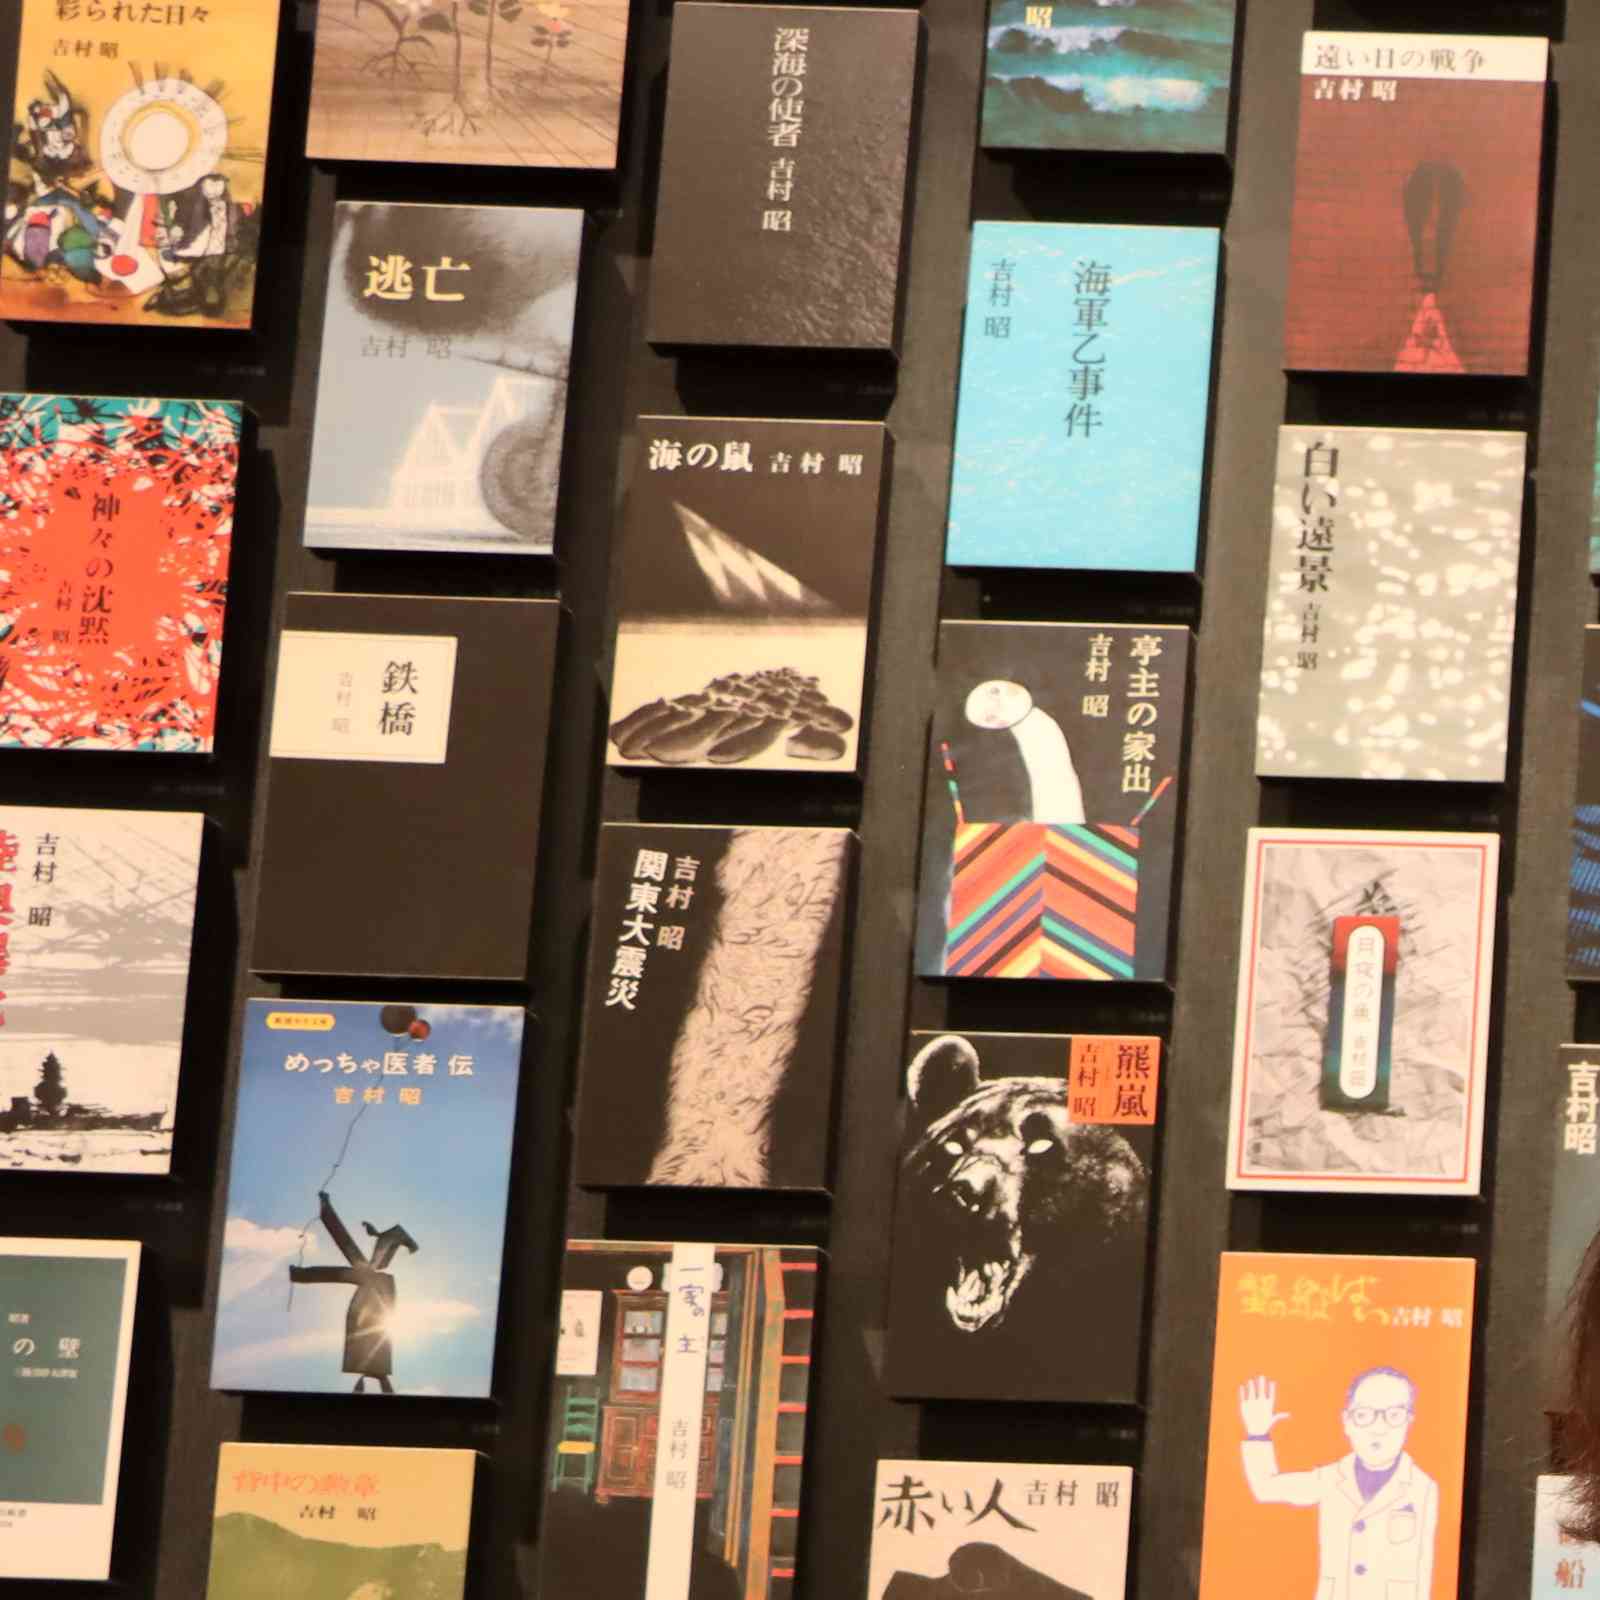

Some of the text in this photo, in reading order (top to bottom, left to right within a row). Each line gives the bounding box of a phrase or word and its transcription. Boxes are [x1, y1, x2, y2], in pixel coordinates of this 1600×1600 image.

[52, 40, 119, 58] 吉村昭
[1315, 45, 1487, 71] 遠い日の戦争
[1313, 80, 1396, 101] 吉村昭
[762, 27, 809, 231] 深海の使者 吉村昭
[364, 256, 470, 302] 逃亡
[984, 259, 1015, 339] 吉村昭
[360, 335, 451, 358] 吉村昭
[1066, 260, 1112, 438] 海軍乙事件
[649, 440, 862, 474] 海の鼠 吉村昭
[77, 493, 120, 645] 神々の沈黙
[1296, 441, 1339, 670] 白い遠景 吉村昭
[331, 672, 353, 735] 吉村昭
[379, 660, 418, 736] 鉄橋
[1082, 635, 1112, 717] 吉村昭
[1123, 635, 1164, 793] 亭主の家出
[28, 833, 60, 927] 吉村昭
[656, 856, 699, 951] 吉村昭
[605, 849, 667, 1010] 関東大震災
[284, 1053, 473, 1077] めっちゃ医者伝
[334, 1087, 422, 1105] 吉村昭
[1074, 1043, 1100, 1116] 吉村昭
[1564, 1060, 1600, 1155] 吉村昭
[666, 1419, 689, 1491] 吉村昭
[878, 1475, 1120, 1534] 赤い人 吉村昭
